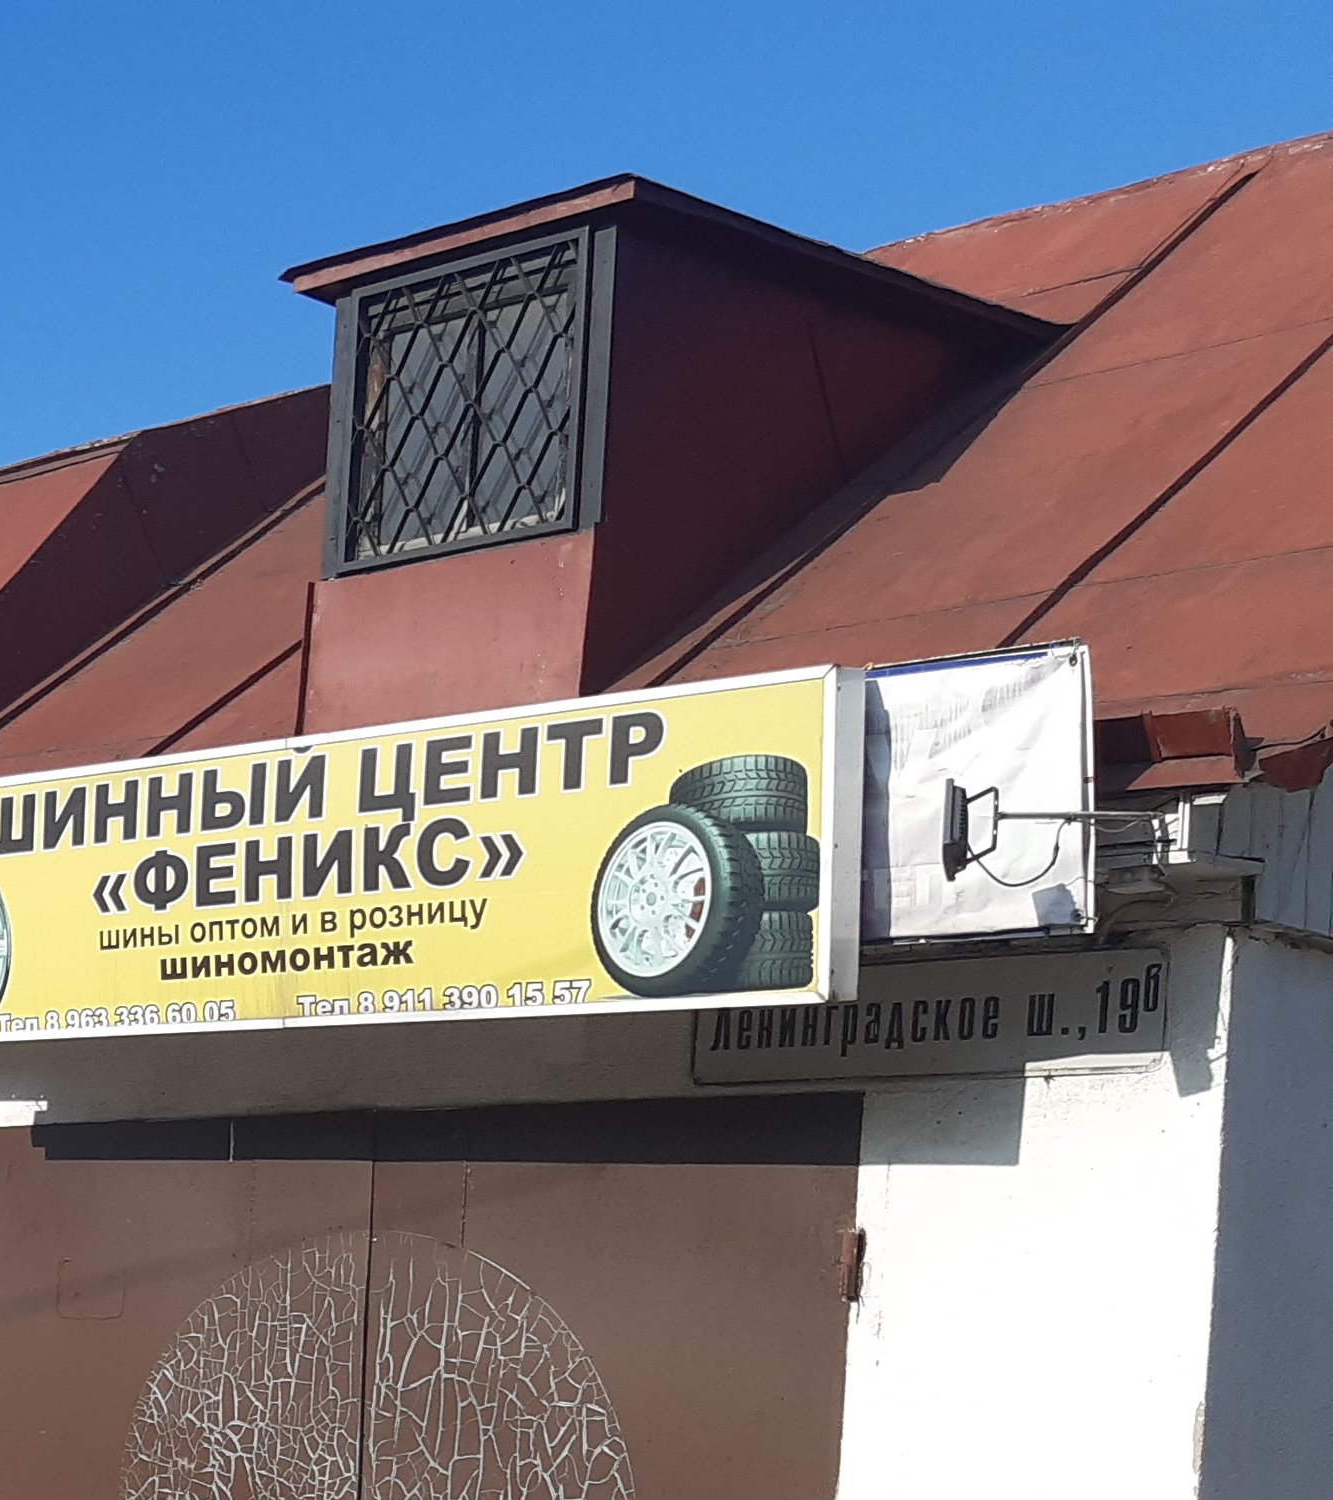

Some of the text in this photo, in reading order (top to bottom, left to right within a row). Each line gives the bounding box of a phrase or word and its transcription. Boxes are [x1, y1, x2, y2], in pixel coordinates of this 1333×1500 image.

[357, 711, 666, 823] ЦЕНТР
[92, 816, 527, 914] «ФЕНИКС»
[98, 898, 489, 951] шины оптом и в розницу
[159, 939, 414, 981] шиномонтаж
[45, 1010, 61, 1032] 8
[166, 1002, 197, 1024] 60
[203, 999, 236, 1022] 05
[296, 978, 592, 1018] Тел 8 911 390 15 57
[709, 996, 1001, 1058] Ленинградское
